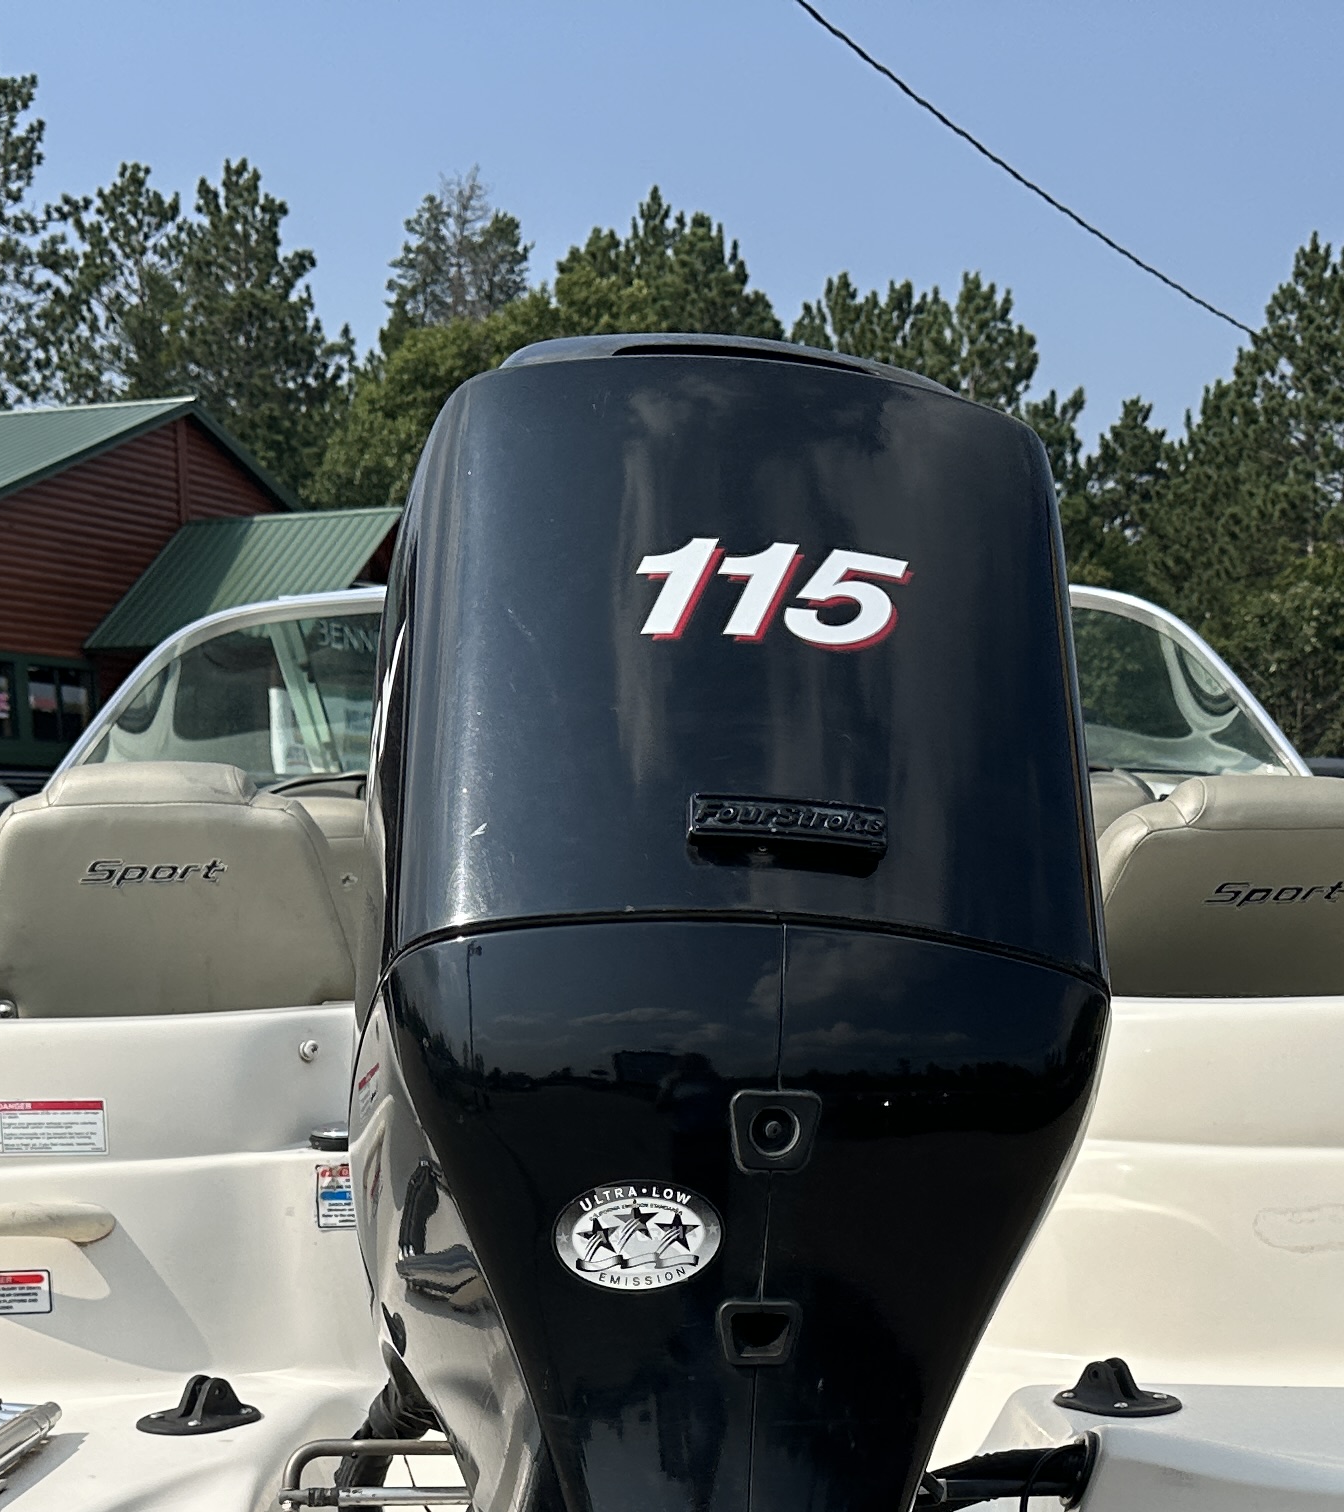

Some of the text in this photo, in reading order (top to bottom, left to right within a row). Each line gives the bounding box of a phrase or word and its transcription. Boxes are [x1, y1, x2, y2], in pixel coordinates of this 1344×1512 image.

[636, 538, 914, 652] 115
[79, 858, 228, 888] Sport
[579, 1186, 692, 1212] ULTRA LOW
[599, 1266, 686, 1287] EMISSION
